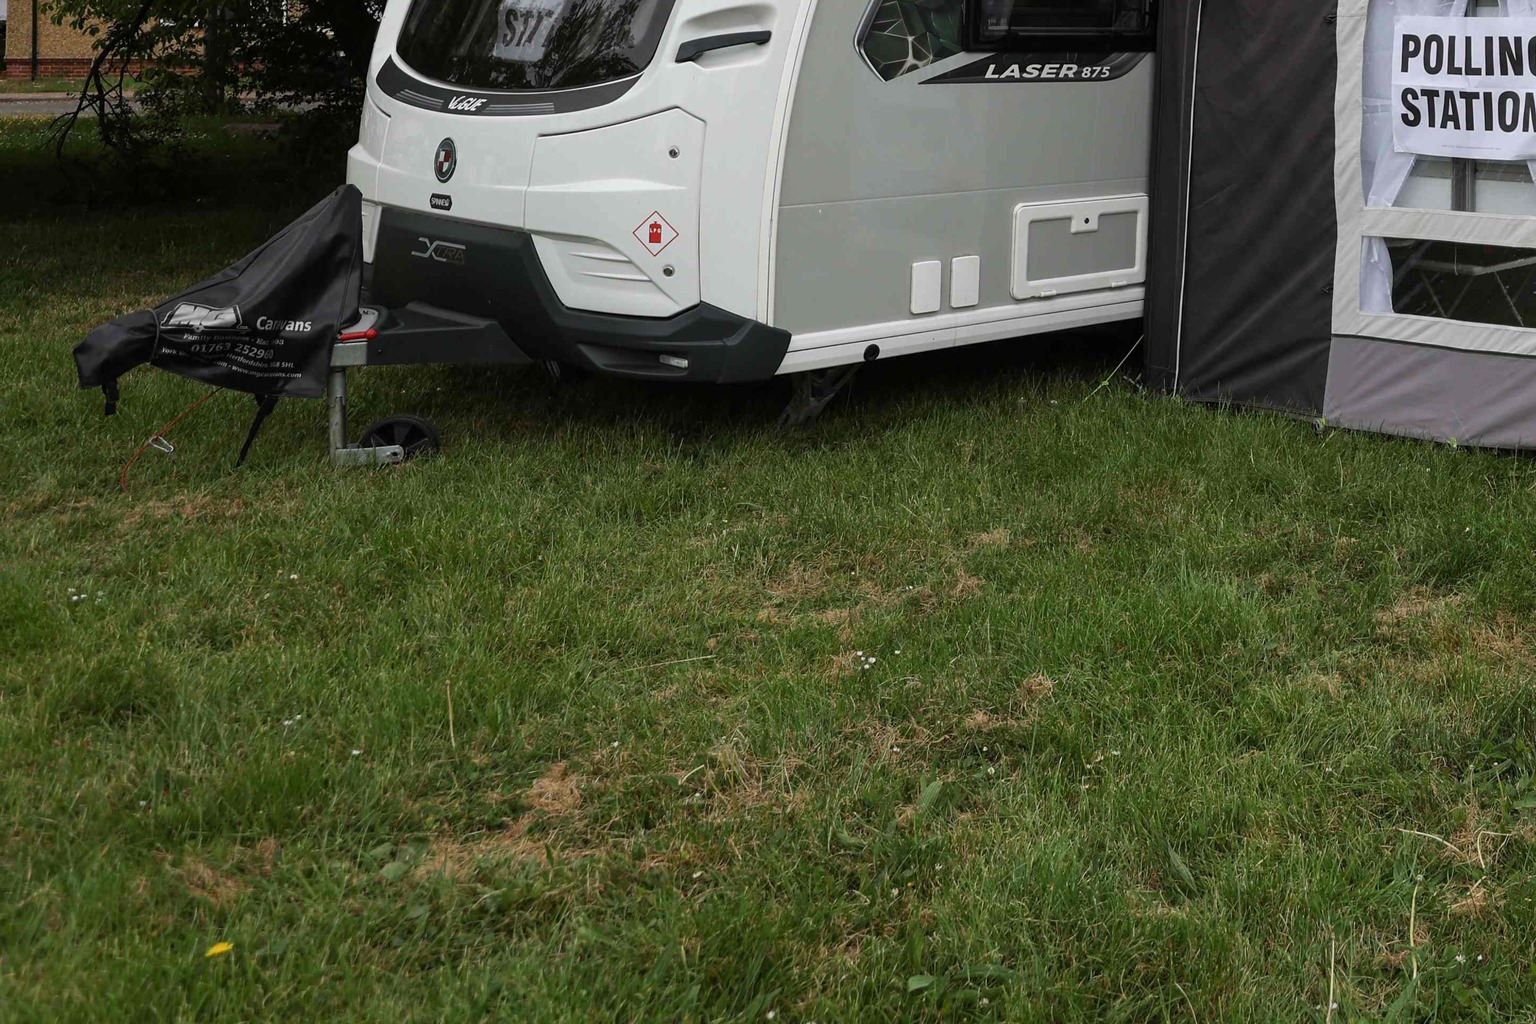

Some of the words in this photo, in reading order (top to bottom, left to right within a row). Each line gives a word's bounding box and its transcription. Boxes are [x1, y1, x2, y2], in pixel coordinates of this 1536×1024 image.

[984, 64, 1038, 79] LASER
[1081, 66, 1111, 78] 875
[448, 95, 487, 112] VOGUE
[191, 342, 232, 354] 01763
